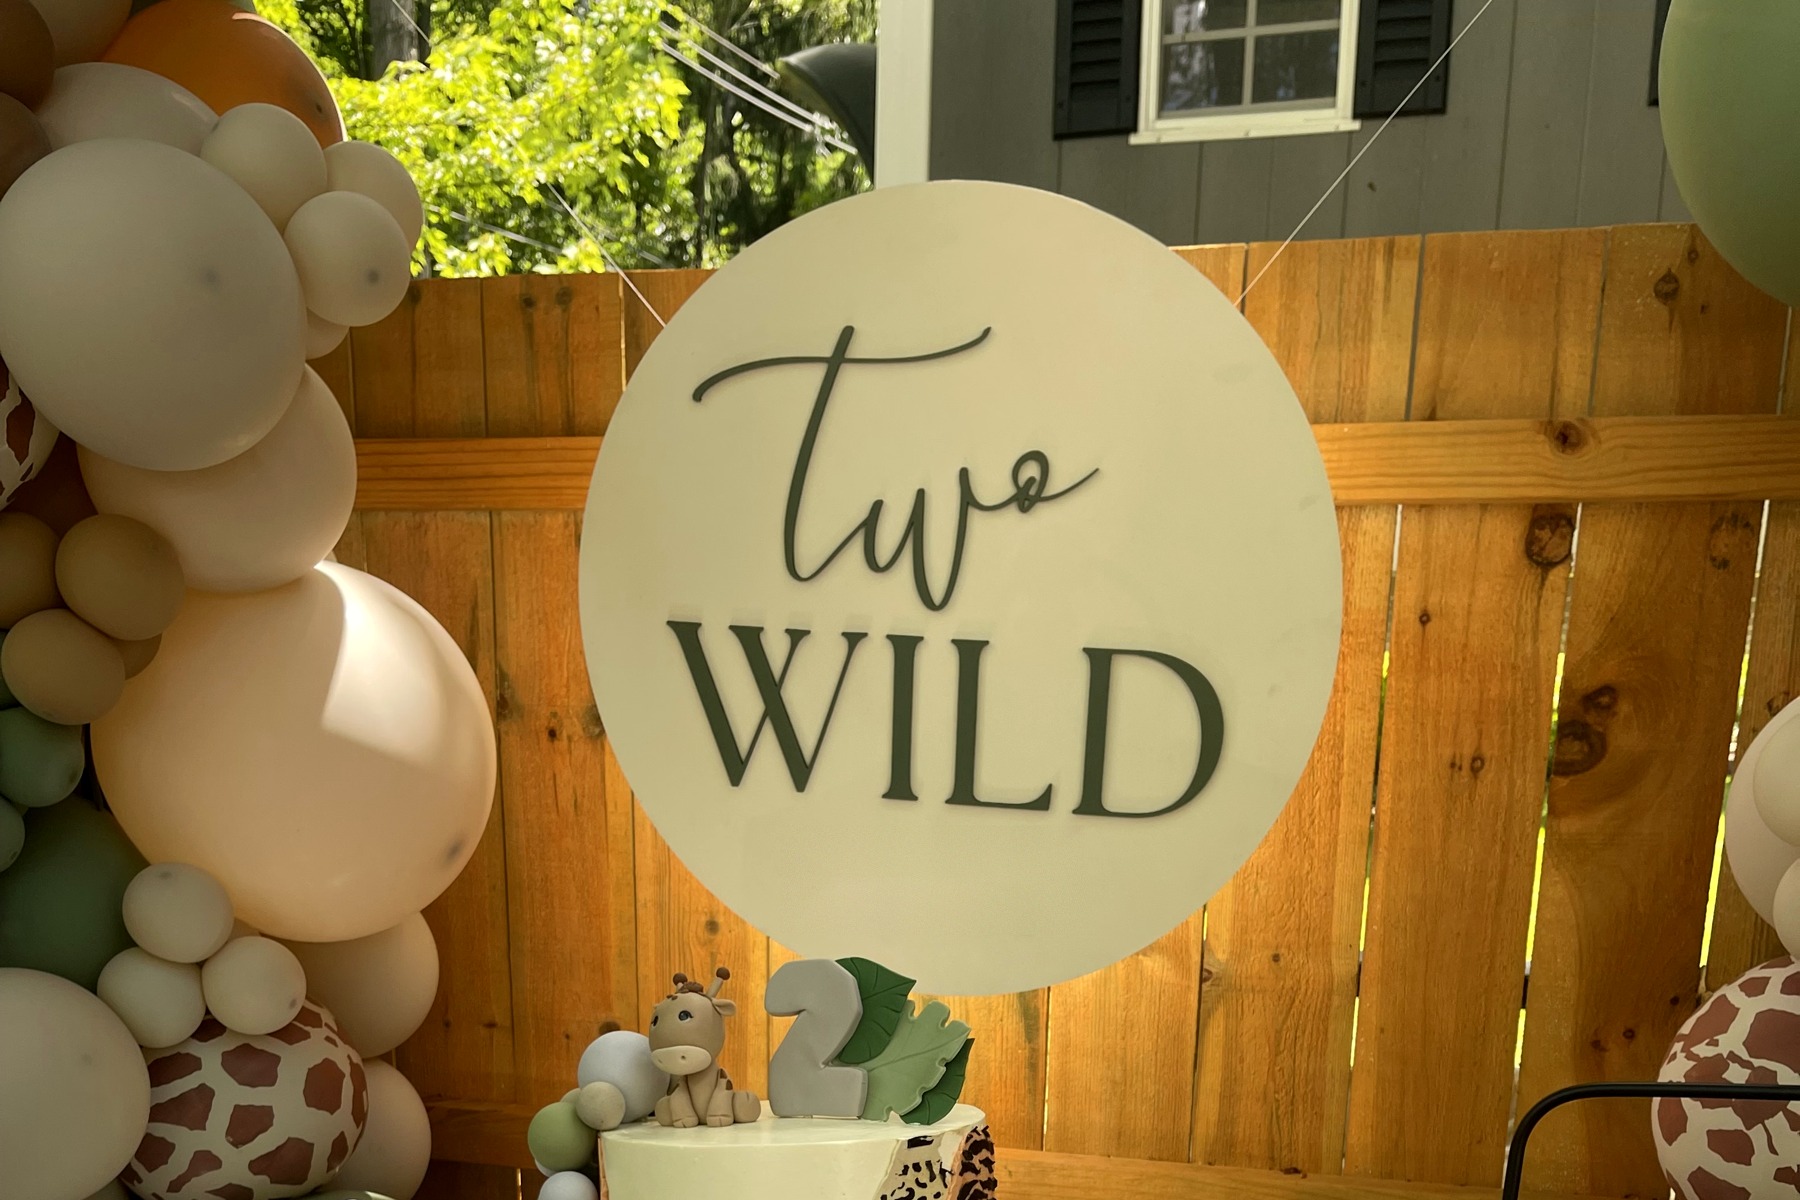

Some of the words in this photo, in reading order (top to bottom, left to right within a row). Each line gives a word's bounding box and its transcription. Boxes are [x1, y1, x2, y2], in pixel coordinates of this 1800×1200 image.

[692, 325, 1100, 612] two
[665, 618, 1226, 819] WILD
[765, 958, 868, 1121] 2
